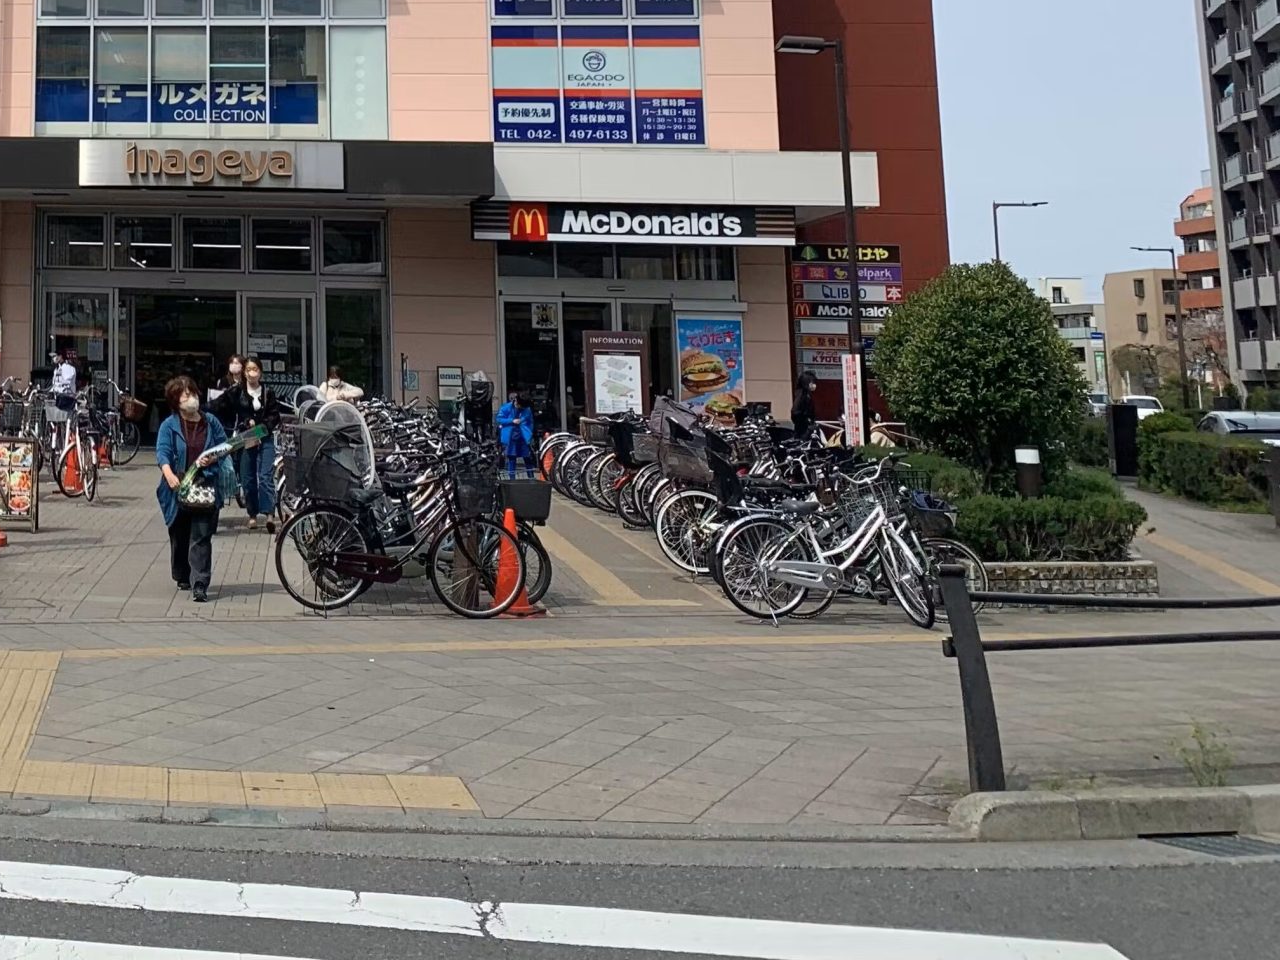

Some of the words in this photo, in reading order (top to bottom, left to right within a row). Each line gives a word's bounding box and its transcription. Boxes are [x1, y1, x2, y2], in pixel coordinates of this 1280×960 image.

[567, 74, 625, 82] EGAODO
[97, 83, 267, 106] エールメガネ
[173, 109, 266, 122] COLLECTION
[501, 107, 551, 118] 予約優先制
[499, 129, 520, 139] TEL
[125, 142, 294, 183] inageya
[561, 210, 742, 237] McDonald's
[856, 267, 892, 280] elpark
[829, 288, 867, 299] LIBO
[887, 287, 901, 300] 本
[589, 337, 644, 345] INFORMATION
